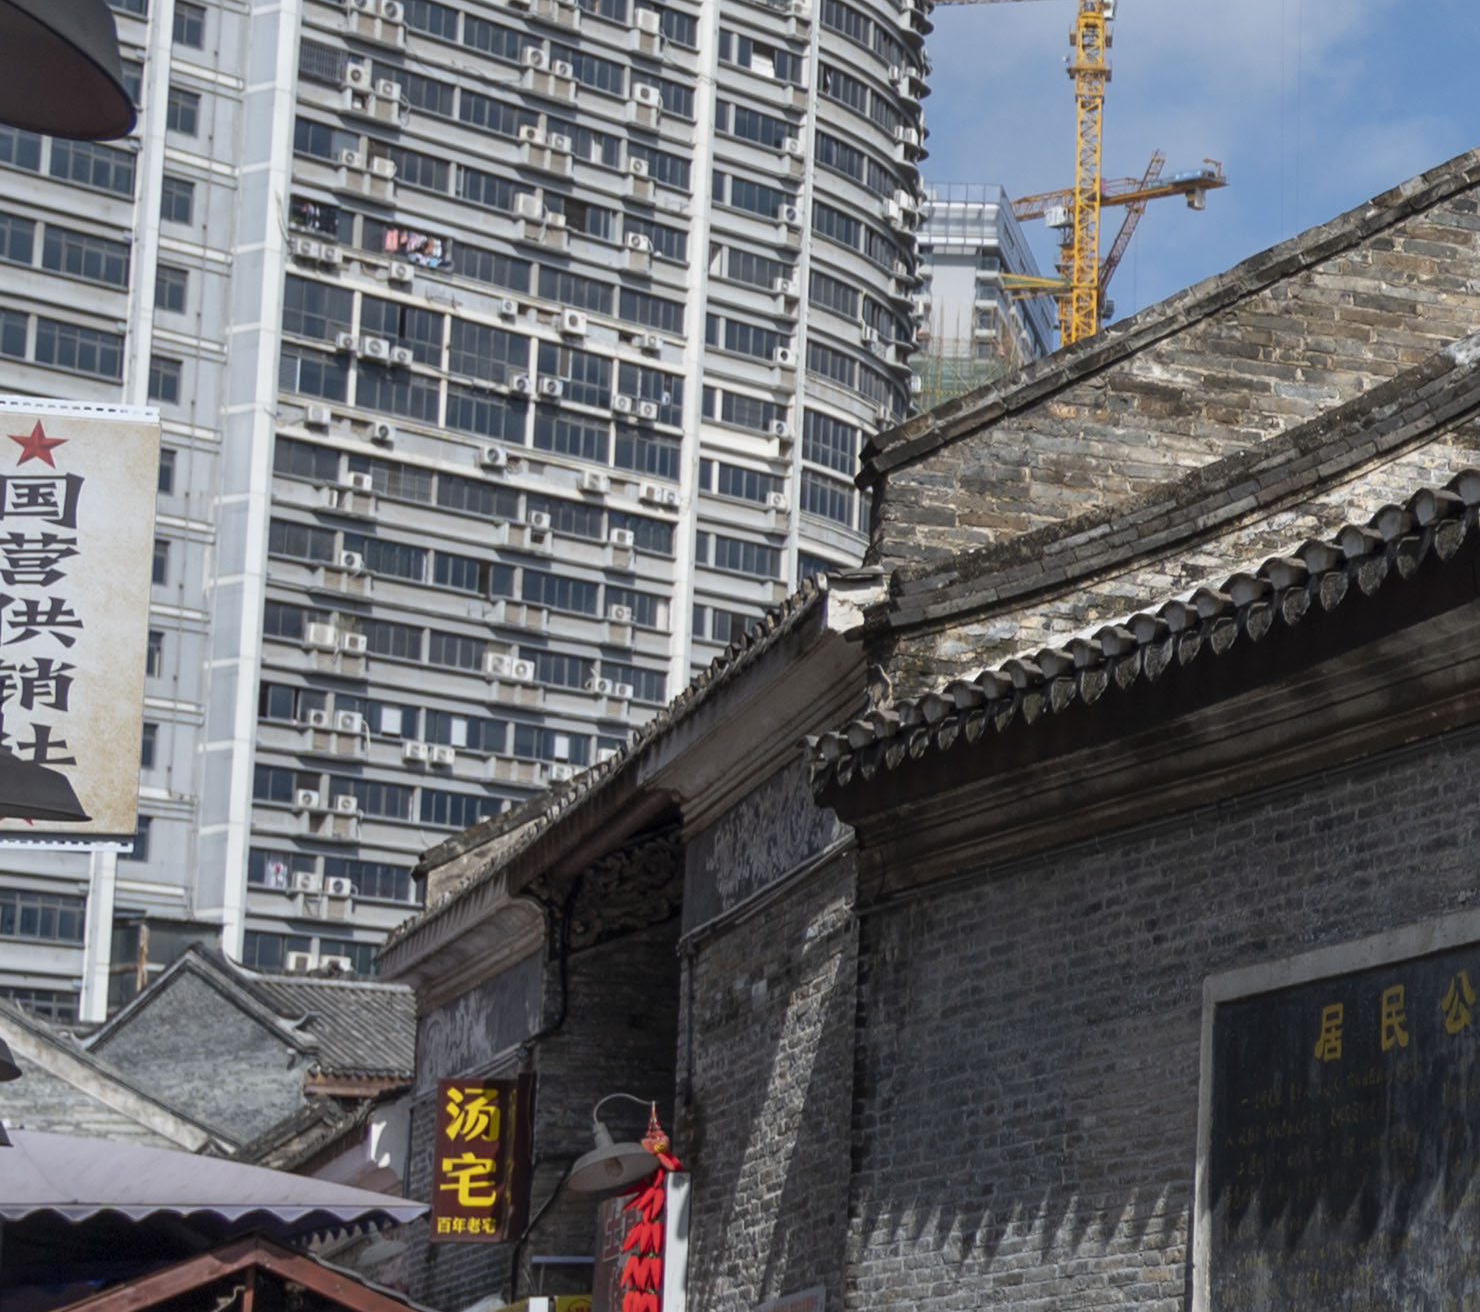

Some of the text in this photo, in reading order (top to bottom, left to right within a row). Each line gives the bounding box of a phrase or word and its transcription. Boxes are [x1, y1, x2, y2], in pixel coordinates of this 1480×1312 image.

[440, 1087, 501, 1207] 汤宅
[436, 1216, 496, 1235] 百年老宅
